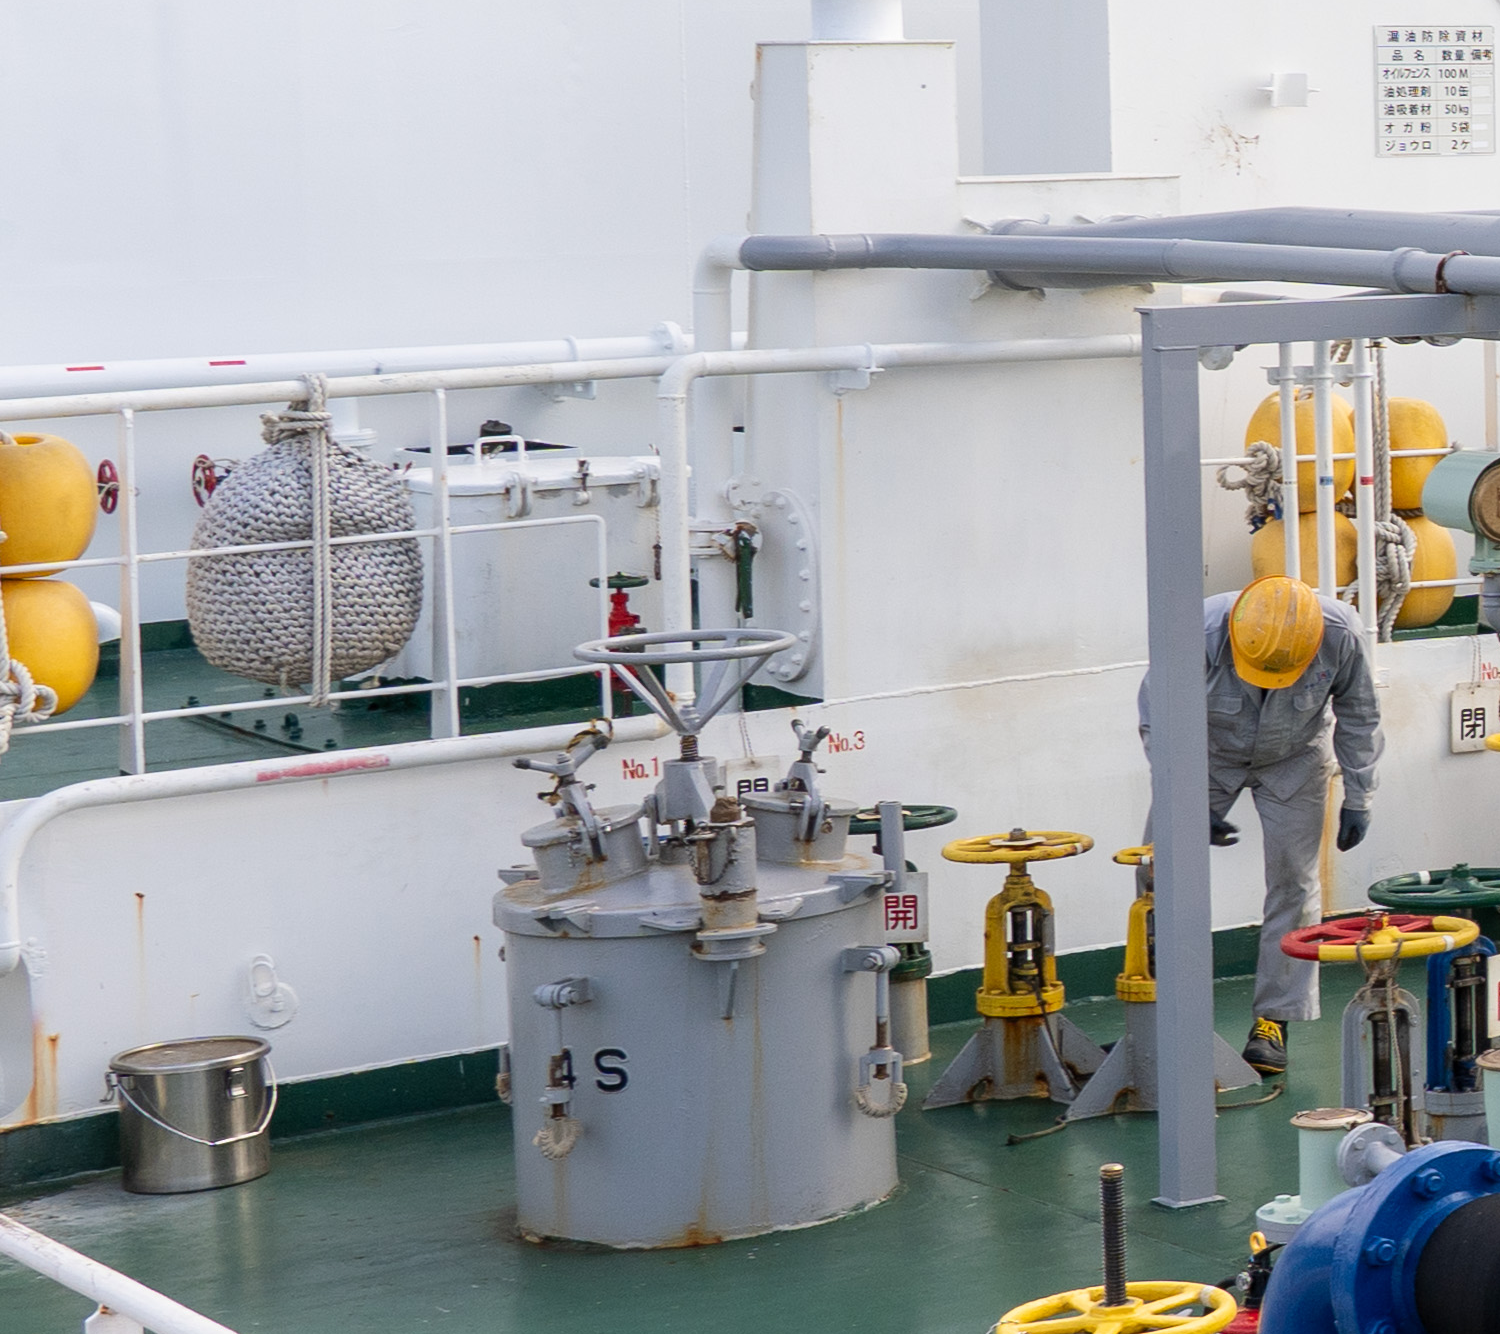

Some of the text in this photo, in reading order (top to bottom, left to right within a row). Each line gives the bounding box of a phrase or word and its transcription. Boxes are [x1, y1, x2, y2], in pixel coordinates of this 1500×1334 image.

[1392, 49, 1424, 61] 品名
[1442, 49, 1465, 61] 数量
[1383, 68, 1431, 79] オイルフェンス
[1383, 86, 1431, 98] 油処理剤
[1384, 104, 1431, 116] 油吸着材
[1385, 140, 1431, 151] ジョウロ
[1460, 707, 1486, 741] 閉
[828, 731, 865, 753] No.3
[622, 757, 659, 780] No.1
[884, 895, 918, 931] 開
